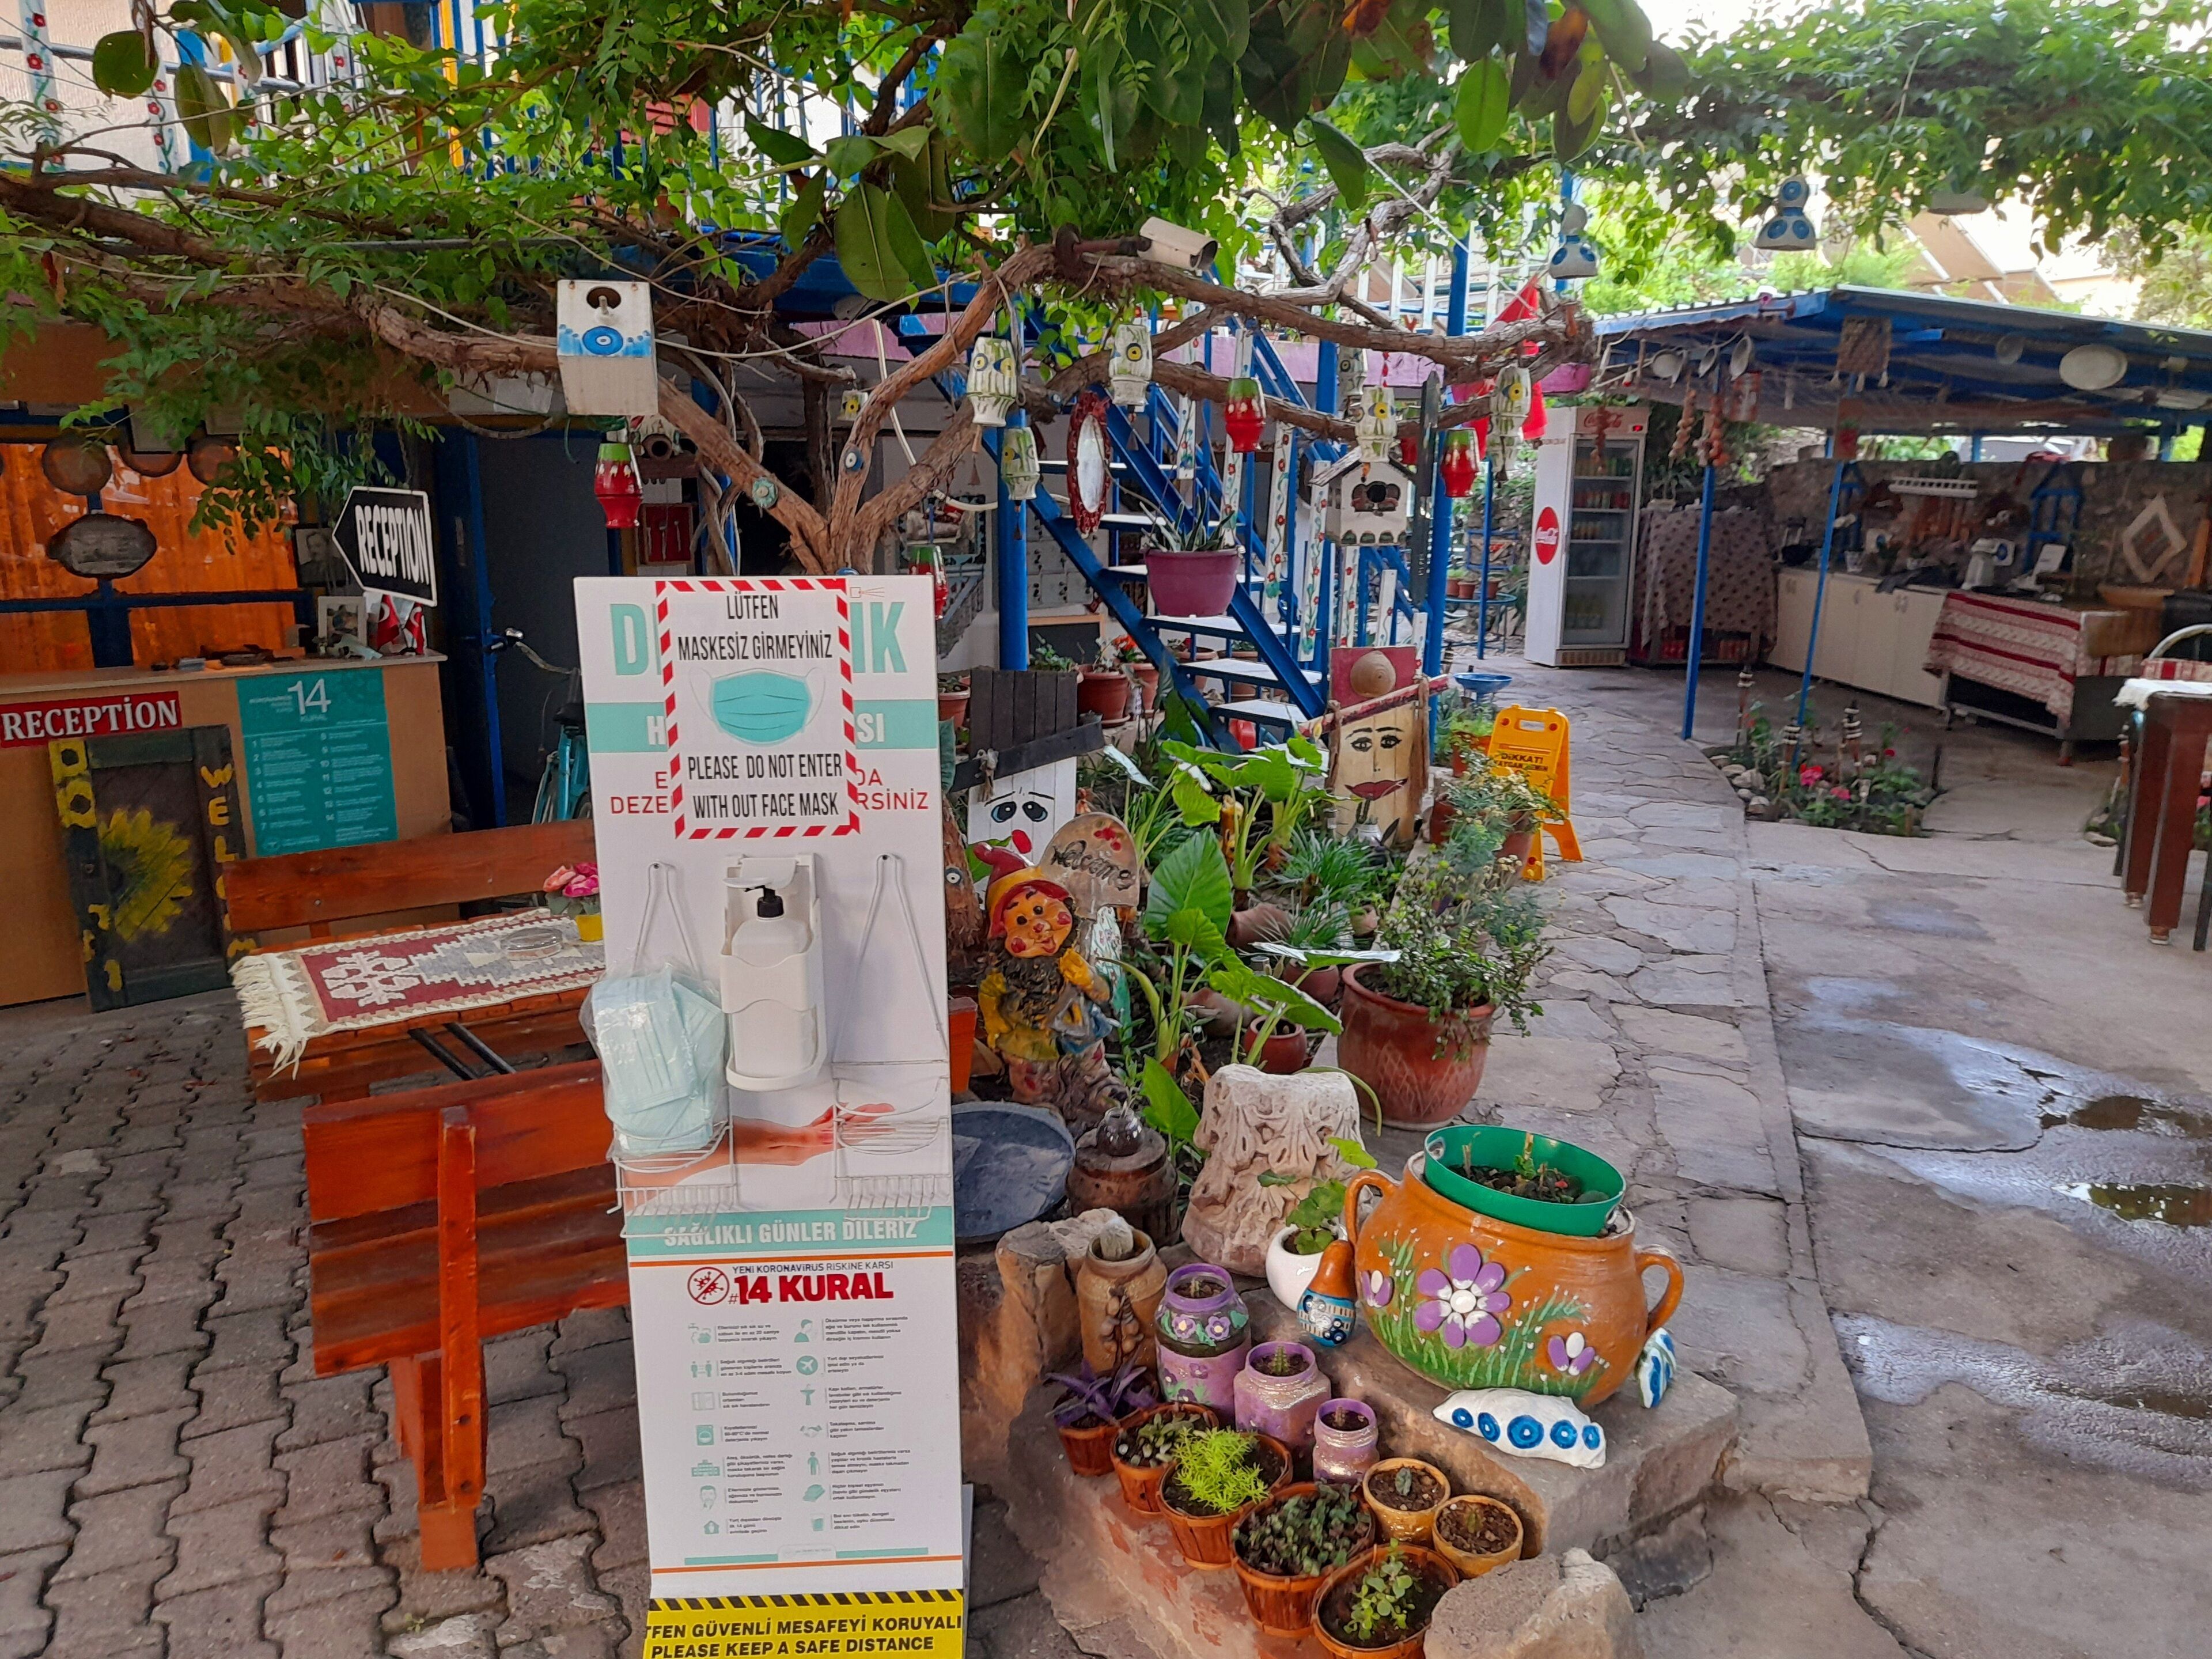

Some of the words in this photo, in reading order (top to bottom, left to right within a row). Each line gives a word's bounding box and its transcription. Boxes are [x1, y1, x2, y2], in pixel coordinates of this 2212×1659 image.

[355, 505, 430, 584] RECEPTION
[726, 591, 779, 620] LÜTFEN
[678, 631, 749, 661] MASKESİZ
[752, 630, 833, 660] GİRMEYİNİZ
[288, 678, 332, 715] 14
[1, 695, 180, 741] RECEPTİON
[688, 755, 738, 780] PLEASE
[747, 755, 765, 778] DO
[769, 754, 797, 778] NOT
[800, 753, 843, 777] ENTER
[693, 795, 729, 819] WITH
[732, 794, 758, 818] OUT
[762, 793, 796, 817] FACE
[801, 792, 839, 816] MASK
[759, 1219, 835, 1244] GÜNLER
[779, 1272, 894, 1302] KURAL
[692, 1618, 771, 1637] GÜVENLİ
[777, 1614, 866, 1634] MESAFEYİ
[651, 1643, 720, 1659] PLEASE
[726, 1642, 773, 1657] KEEP
[777, 1641, 789, 1654] A
[795, 1639, 840, 1654] SAFE
[846, 1637, 934, 1653] DISTANCE
